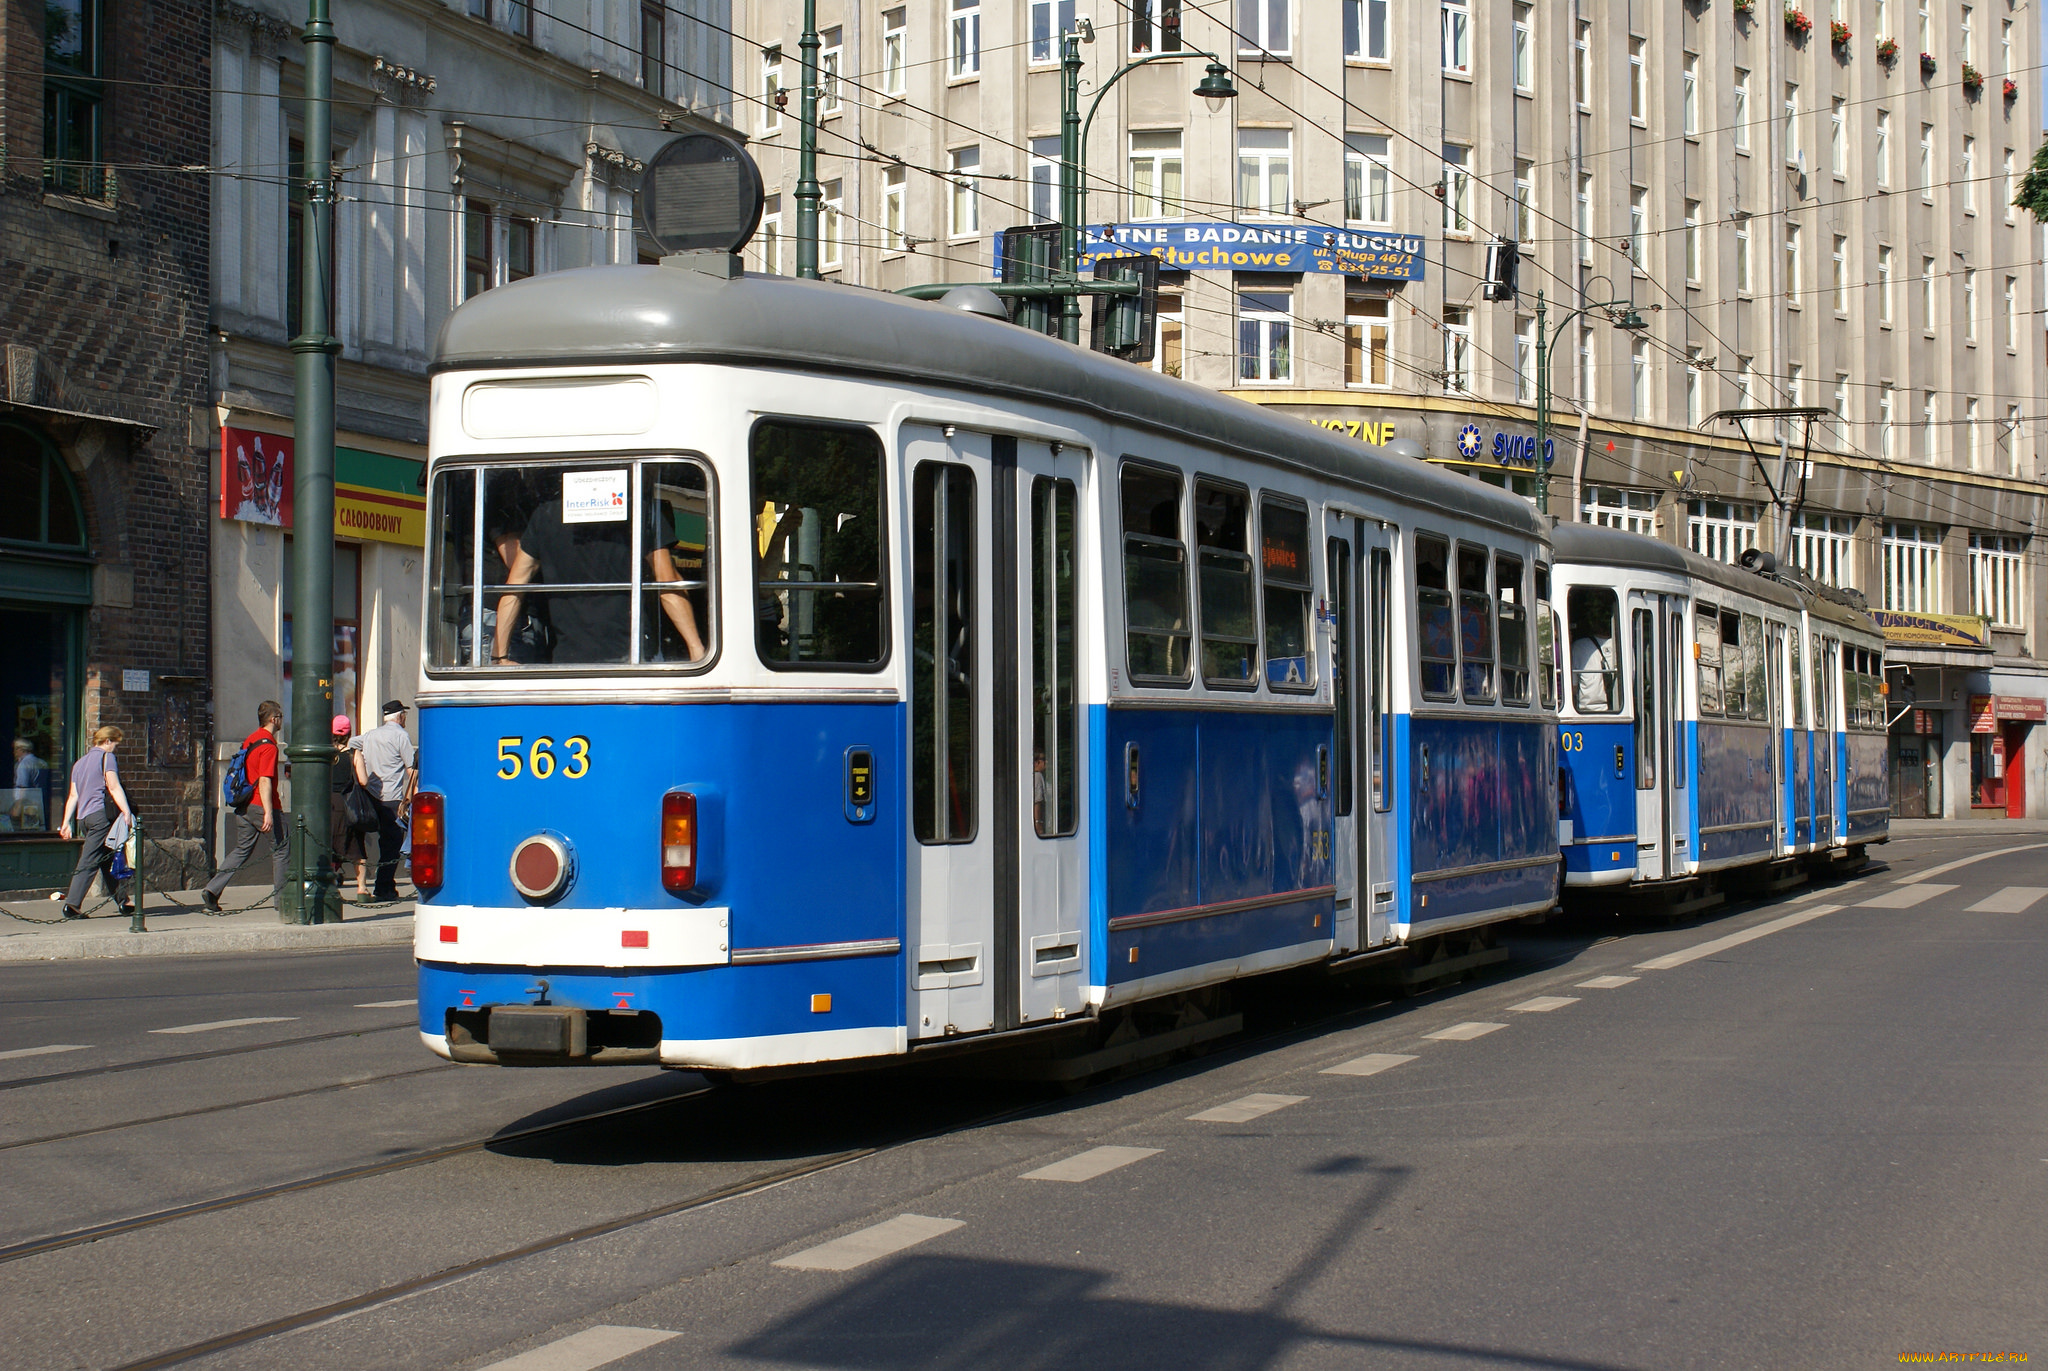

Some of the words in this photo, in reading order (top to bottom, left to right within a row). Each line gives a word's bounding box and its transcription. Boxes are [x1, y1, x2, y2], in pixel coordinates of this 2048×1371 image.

[1185, 227, 1307, 244] BADANIE
[1323, 232, 1419, 253] SŁUCHU
[1150, 246, 1291, 266] Słuchowe
[1313, 248, 1331, 257] ul.
[1337, 249, 1376, 262] Długa
[1379, 253, 1412, 264] 46/1
[1338, 262, 1410, 276] 634-25-51
[1306, 420, 1395, 447] ZNE
[1493, 433, 1554, 464] syneo
[566, 498, 610, 509] InterRisk
[340, 508, 402, 534] CAŁODOBOWY
[497, 735, 591, 780] 563
